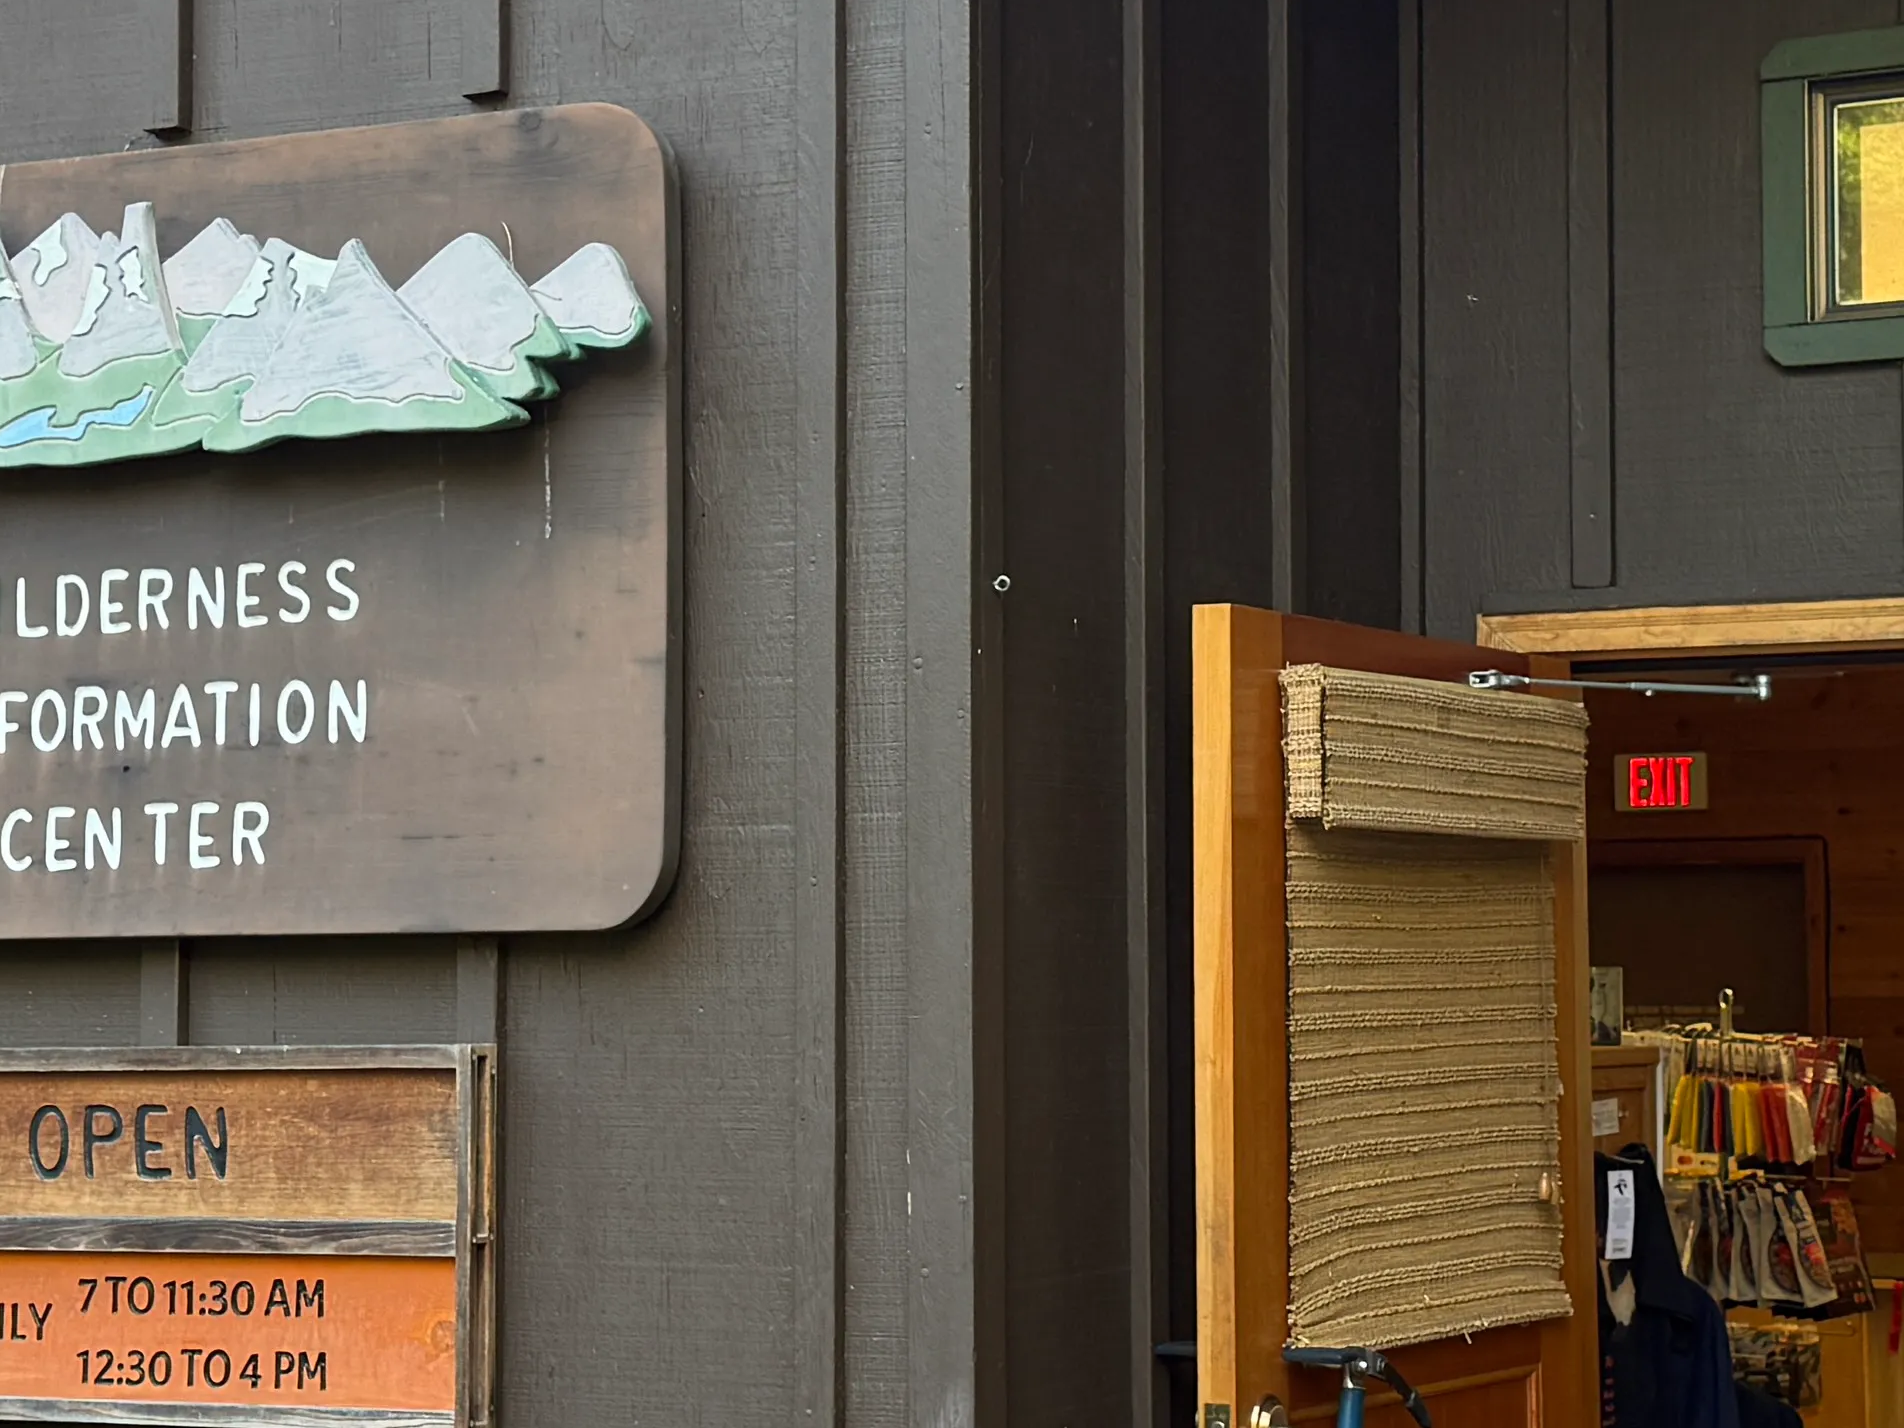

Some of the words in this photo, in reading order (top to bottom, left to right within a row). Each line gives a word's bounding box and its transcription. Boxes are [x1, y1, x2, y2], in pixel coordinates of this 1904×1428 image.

[1629, 756, 1694, 807] EXIT
[0, 800, 271, 872] CENTER
[27, 1103, 230, 1182] OPEN
[76, 1277, 98, 1316] 7
[104, 1276, 156, 1316] TO
[161, 1278, 256, 1319] 11:30
[263, 1278, 326, 1320] AM
[74, 1349, 173, 1388] 12:30
[177, 1348, 232, 1390] TO
[238, 1351, 263, 1391] 4
[273, 1350, 328, 1392] PM
